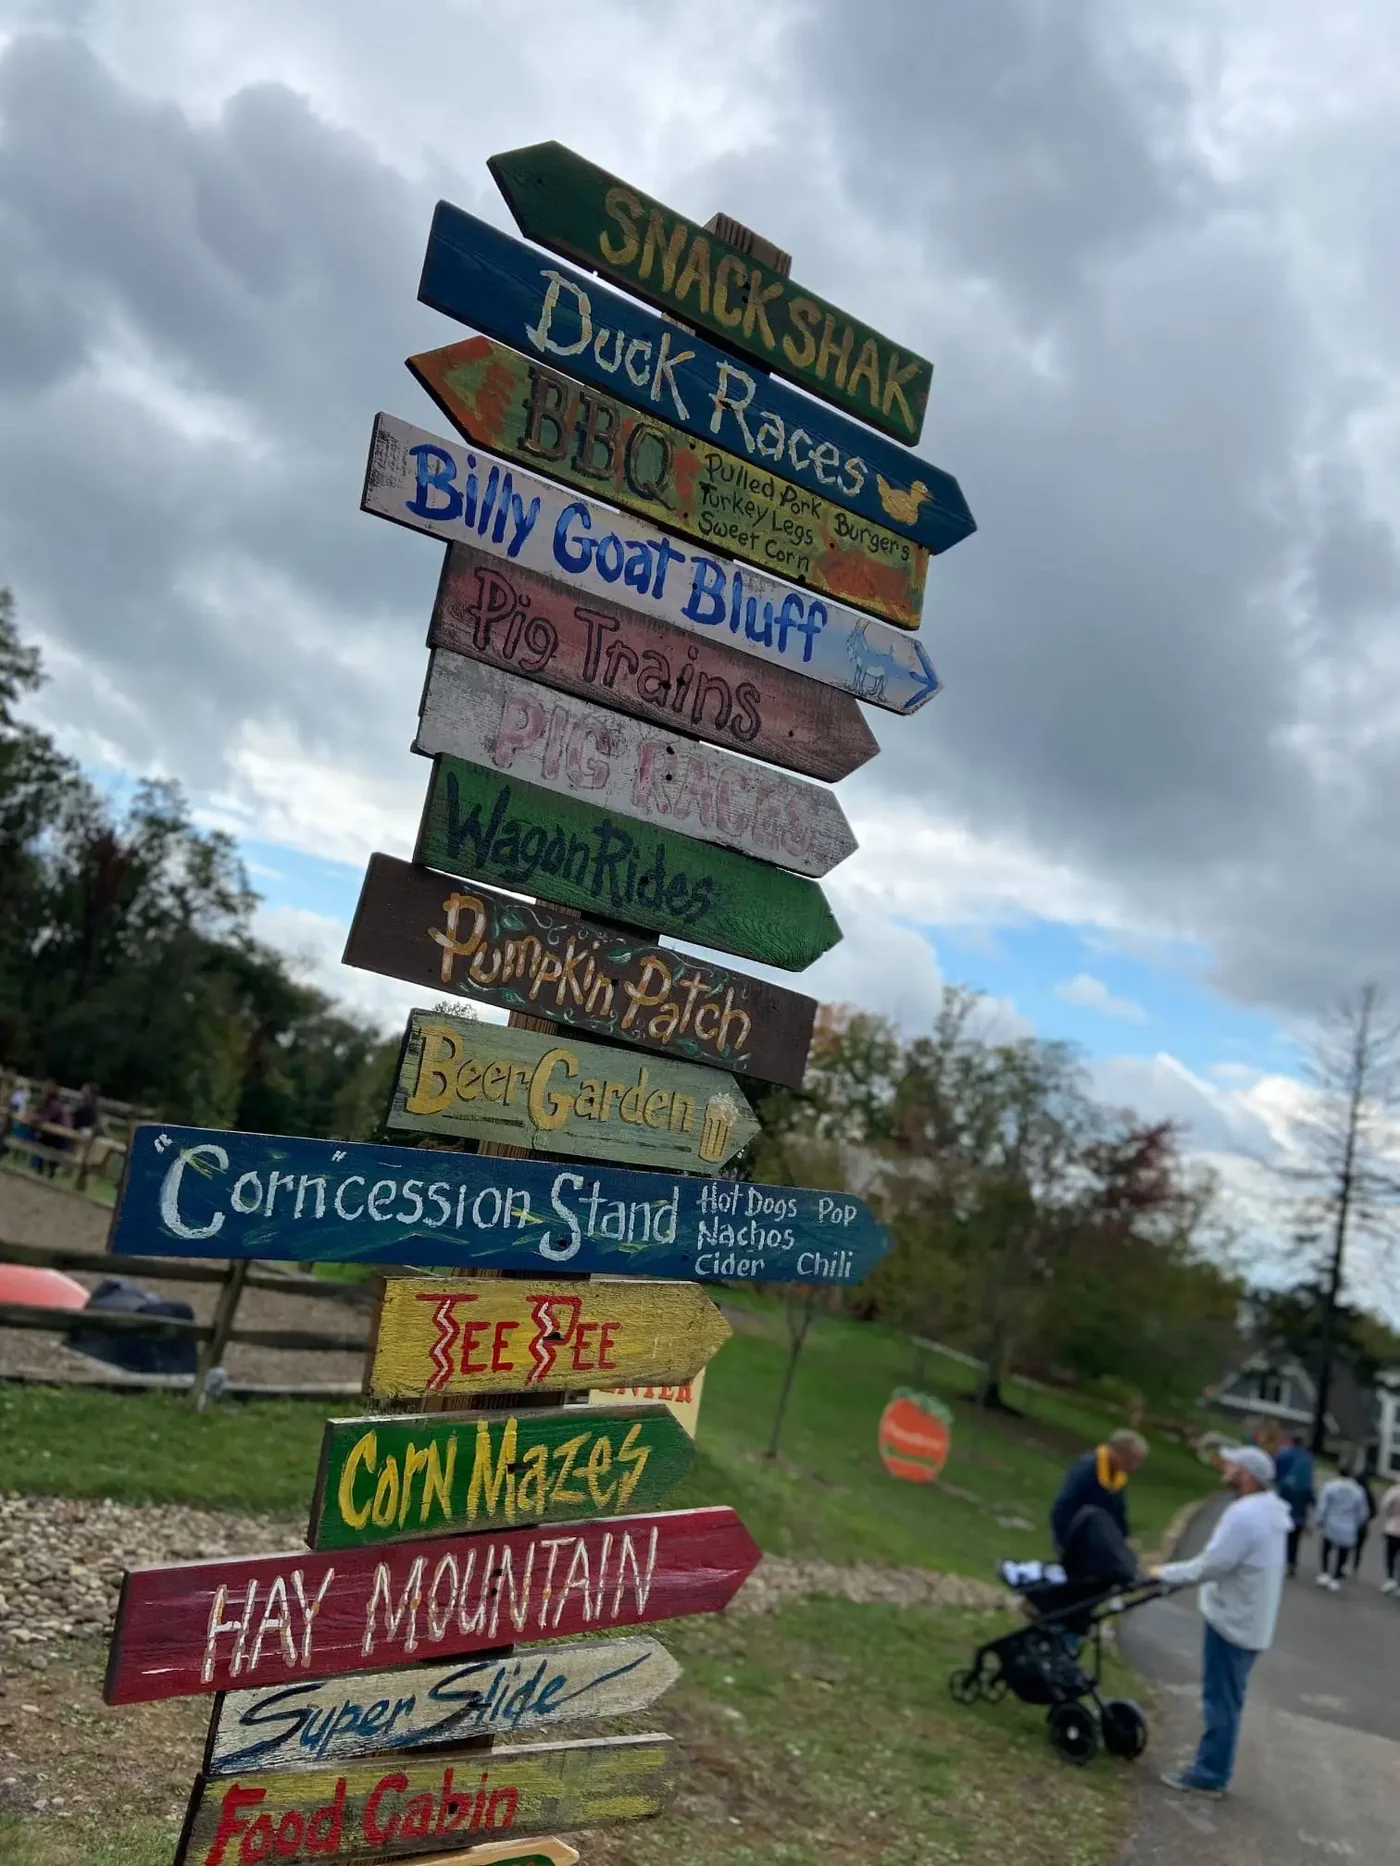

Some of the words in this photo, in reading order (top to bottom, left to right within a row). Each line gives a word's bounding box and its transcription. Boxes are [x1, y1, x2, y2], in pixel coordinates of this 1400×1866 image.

[599, 187, 785, 349] SNACK
[782, 298, 920, 434] SHAK
[517, 366, 678, 511] BBQ
[526, 270, 696, 421] Duck
[710, 361, 868, 496] Races
[405, 443, 541, 557] Billy
[553, 501, 686, 600] Goat
[681, 556, 828, 663] Bluff
[698, 511, 759, 549] Sweet
[765, 539, 809, 572] Corn
[699, 481, 768, 526] Turkey
[772, 510, 813, 546] Legs
[705, 453, 775, 500] Pulled
[780, 486, 821, 519] Pork
[834, 513, 910, 560] Burgers
[471, 566, 558, 671] Pig
[575, 606, 764, 742] Trains
[492, 697, 610, 789] PIG
[633, 741, 815, 857] RACES
[446, 771, 590, 886] Wagon
[589, 819, 715, 923] Rides
[427, 892, 613, 1018] Pumpkin
[621, 954, 752, 1053] Patch
[402, 1024, 531, 1115] Beer
[528, 1047, 696, 1133] Garden
[539, 1172, 679, 1261] Stand
[697, 1216, 796, 1251] Nachos
[699, 1181, 743, 1216] Hot
[745, 1187, 798, 1222] Dogs
[818, 1197, 857, 1227] Pop
[695, 1250, 765, 1277] Cider
[796, 1250, 854, 1278] Chili
[200, 1567, 335, 1684] HAY
[361, 1525, 659, 1654] MOUNTAIN
[208, 1680, 416, 1772] Super
[393, 1653, 651, 1747] Slide
[203, 1777, 346, 1866] Food
[363, 1767, 518, 1847] Cabin
